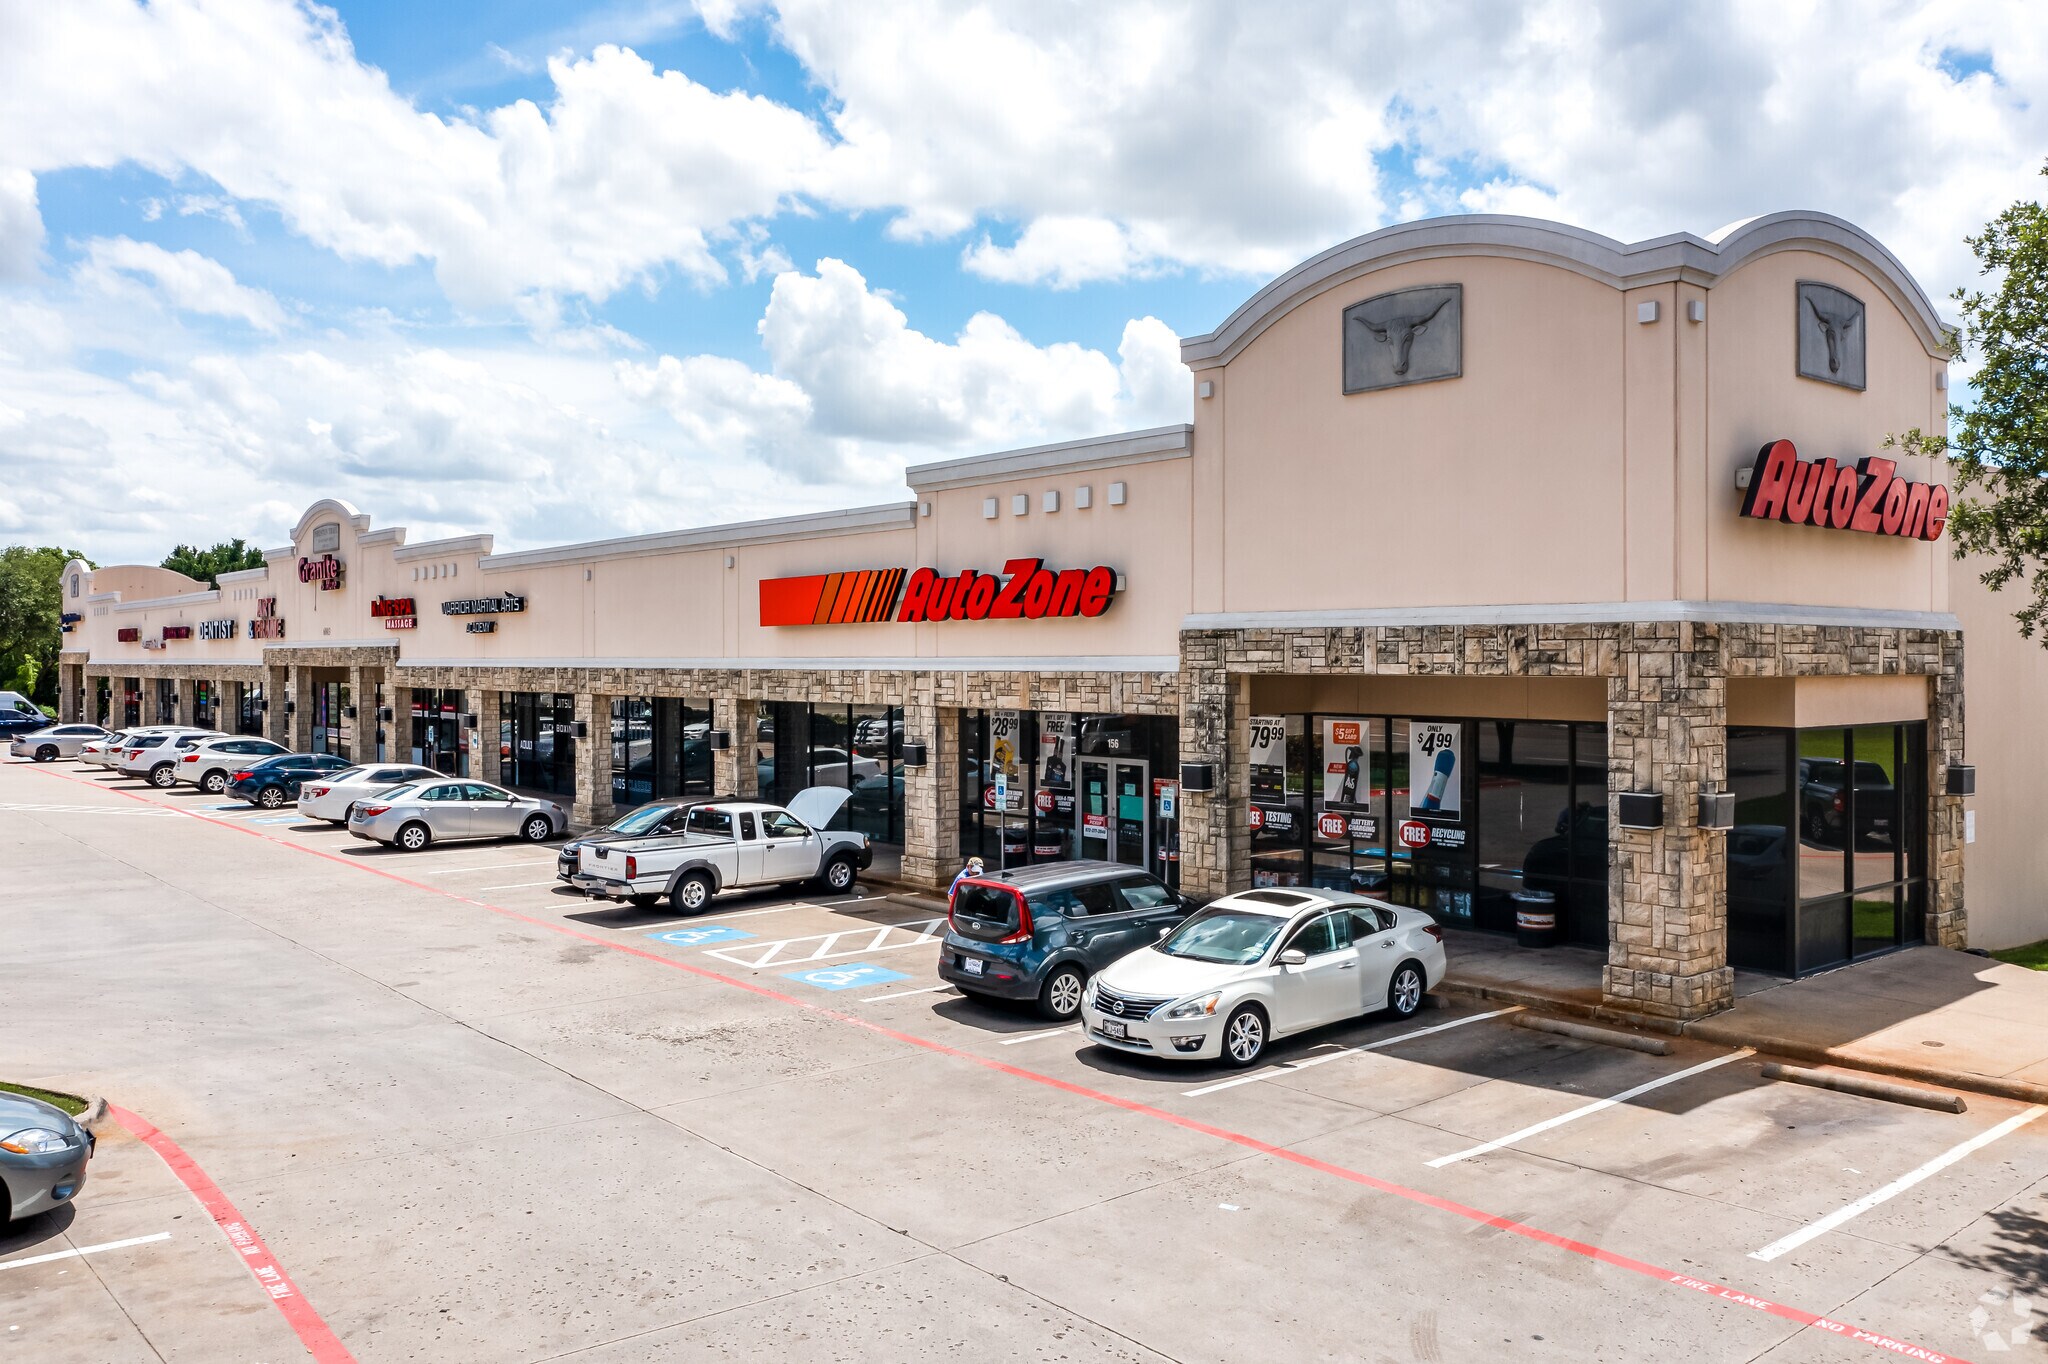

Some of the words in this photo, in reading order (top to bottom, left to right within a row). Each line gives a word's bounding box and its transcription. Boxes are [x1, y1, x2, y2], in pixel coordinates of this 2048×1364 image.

[1742, 438, 1950, 541] AutoZone
[298, 555, 339, 583] Granite
[896, 558, 1117, 622] AutoZone
[394, 599, 412, 616] SPA
[442, 601, 470, 615] WARRIOR
[471, 600, 499, 614] MARTIAL
[500, 598, 520, 611] ARTS
[200, 620, 234, 640] DENTIST
[386, 619, 413, 629] MASSAGE
[466, 622, 491, 633] ACADEMY
[556, 698, 572, 709] JITSU
[556, 724, 572, 733] BOXIN
[1047, 721, 1065, 733] FREE
[519, 739, 533, 750] ADULT
[1107, 739, 1119, 749] 156
[613, 777, 626, 790] KIDS
[1037, 795, 1052, 807] FREE
[1265, 811, 1292, 824] TESTING
[1351, 818, 1374, 826] BATTERY
[1322, 818, 1343, 834] FREE
[1404, 826, 1426, 843] FREE
[1431, 828, 1466, 840] RECYCLING
[588, 863, 619, 872] FRONTIER
[1670, 1275, 1716, 1292] FIRE
[1719, 1290, 1774, 1310] LANE
[1815, 1318, 1846, 1332] NO
[1853, 1330, 1946, 1364] PARKING
